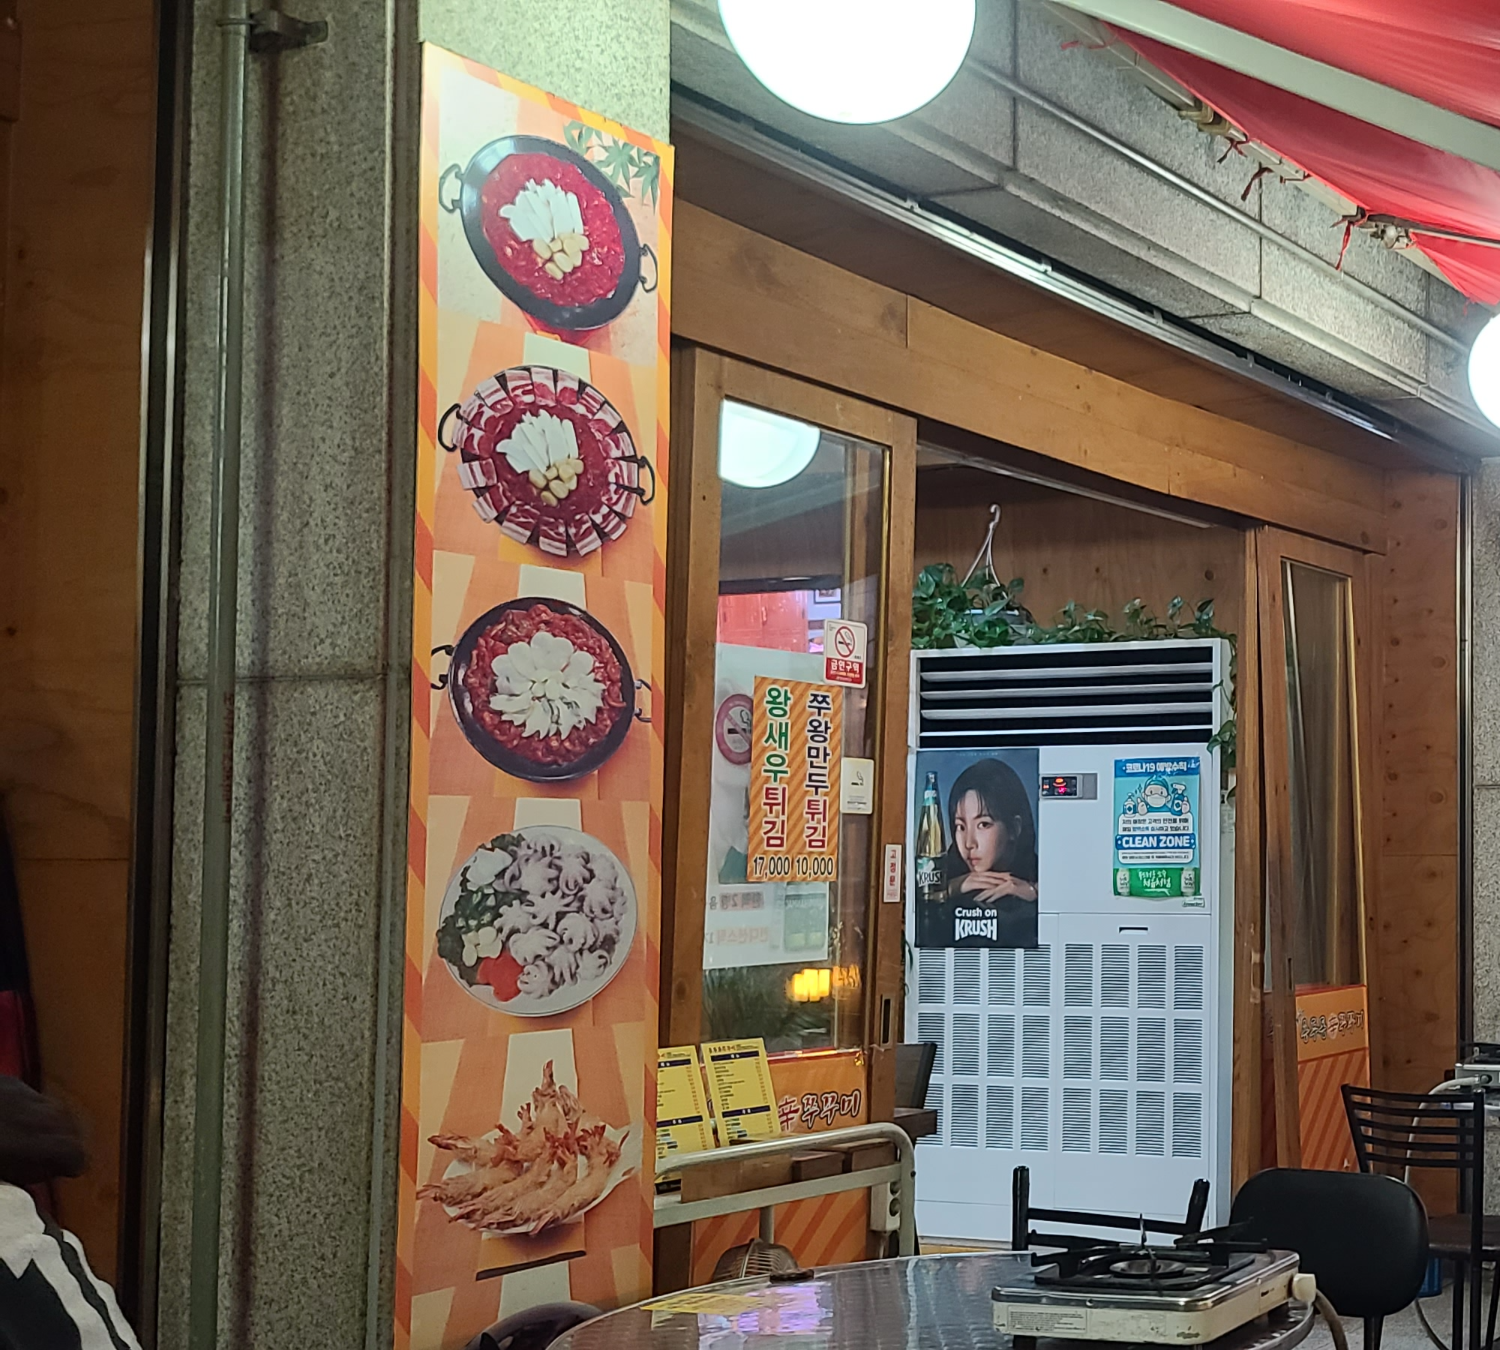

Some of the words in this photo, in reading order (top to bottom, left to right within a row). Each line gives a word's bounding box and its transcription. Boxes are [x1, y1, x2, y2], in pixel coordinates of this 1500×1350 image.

[831, 659, 860, 674] 금연구역
[762, 686, 792, 849] 왕새우튀김
[804, 692, 832, 850] 쭈왕만두튀김
[1122, 836, 1157, 848] CLEAN
[1159, 835, 1190, 847] ZONE
[753, 856, 791, 878] 17,000
[796, 856, 834, 879] 10,000
[955, 907, 982, 918] Crush
[985, 909, 997, 918] on
[955, 918, 998, 941] KRUSH
